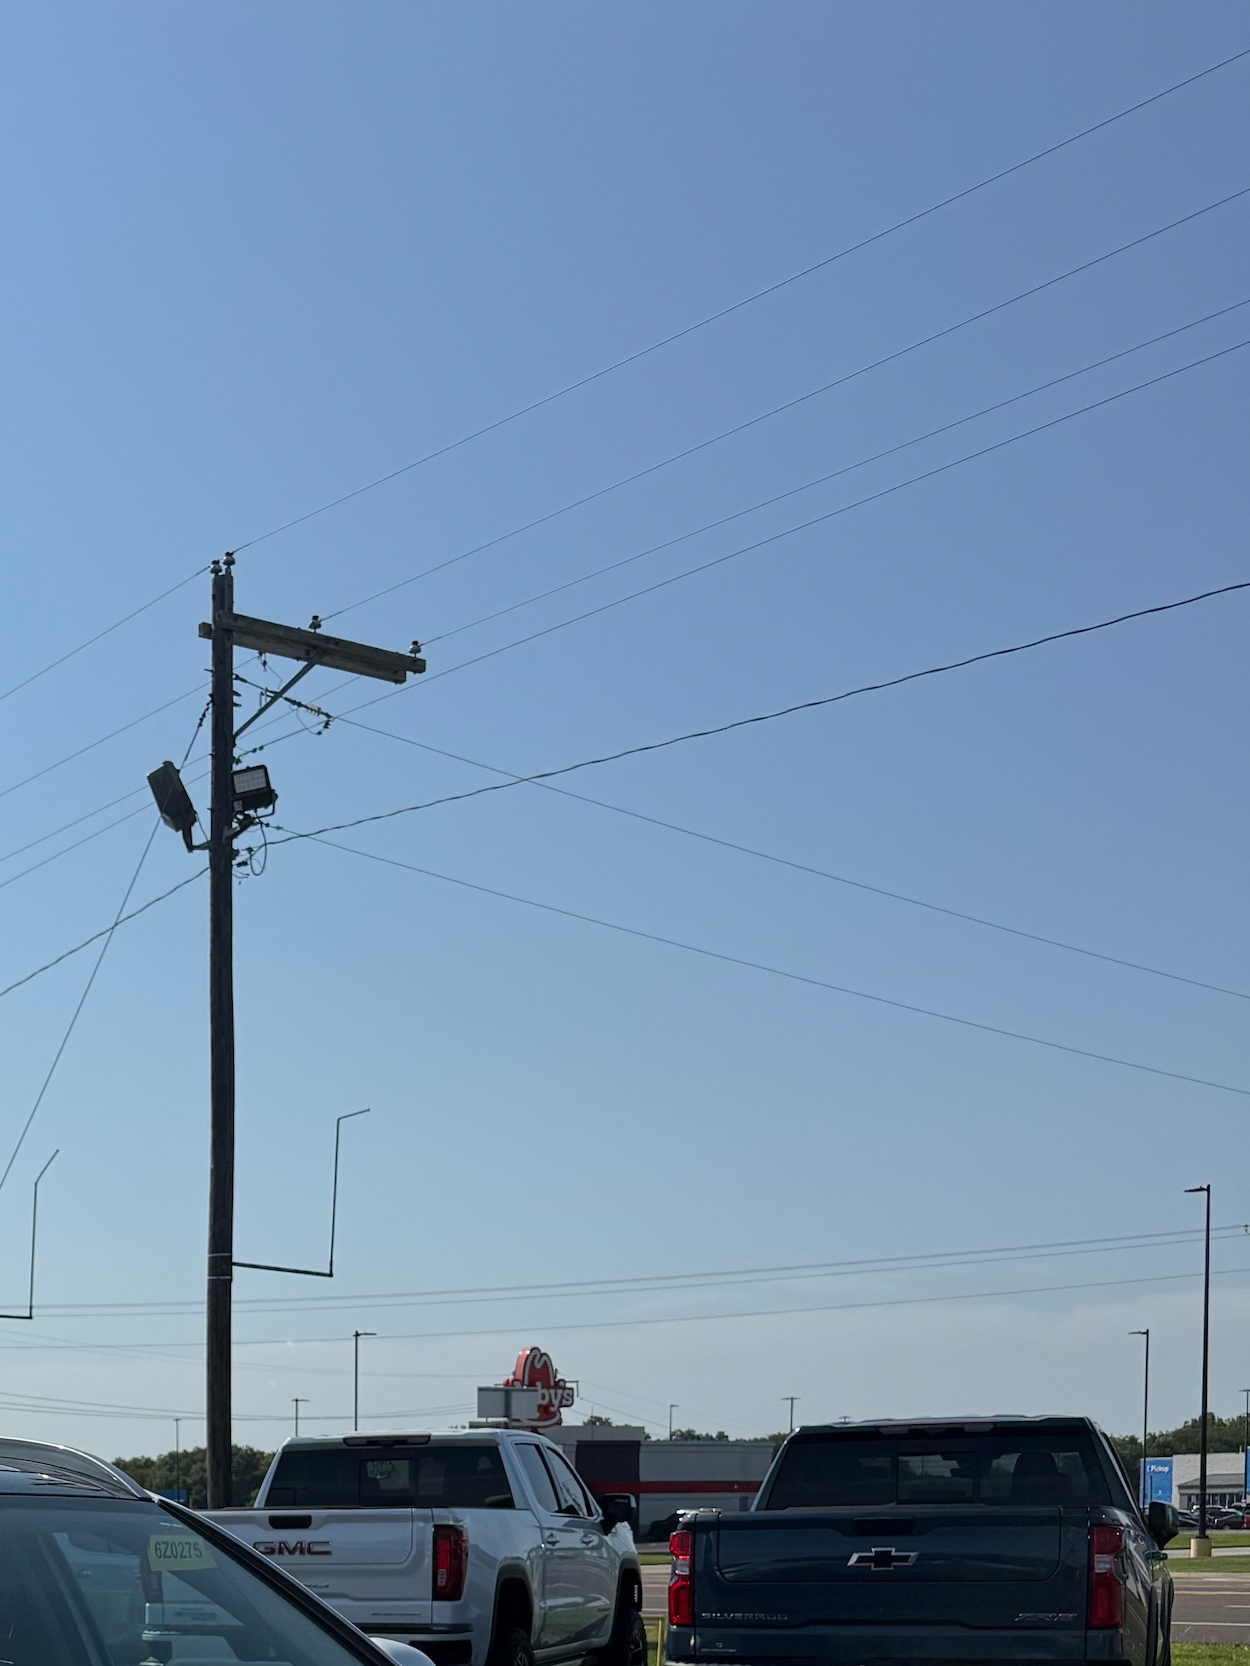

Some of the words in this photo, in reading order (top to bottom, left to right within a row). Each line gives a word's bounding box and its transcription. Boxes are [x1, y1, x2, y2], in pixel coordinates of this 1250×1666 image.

[513, 1379, 574, 1412] by's
[154, 1540, 203, 1559] 6Z0275
[252, 1541, 332, 1556] GMC
